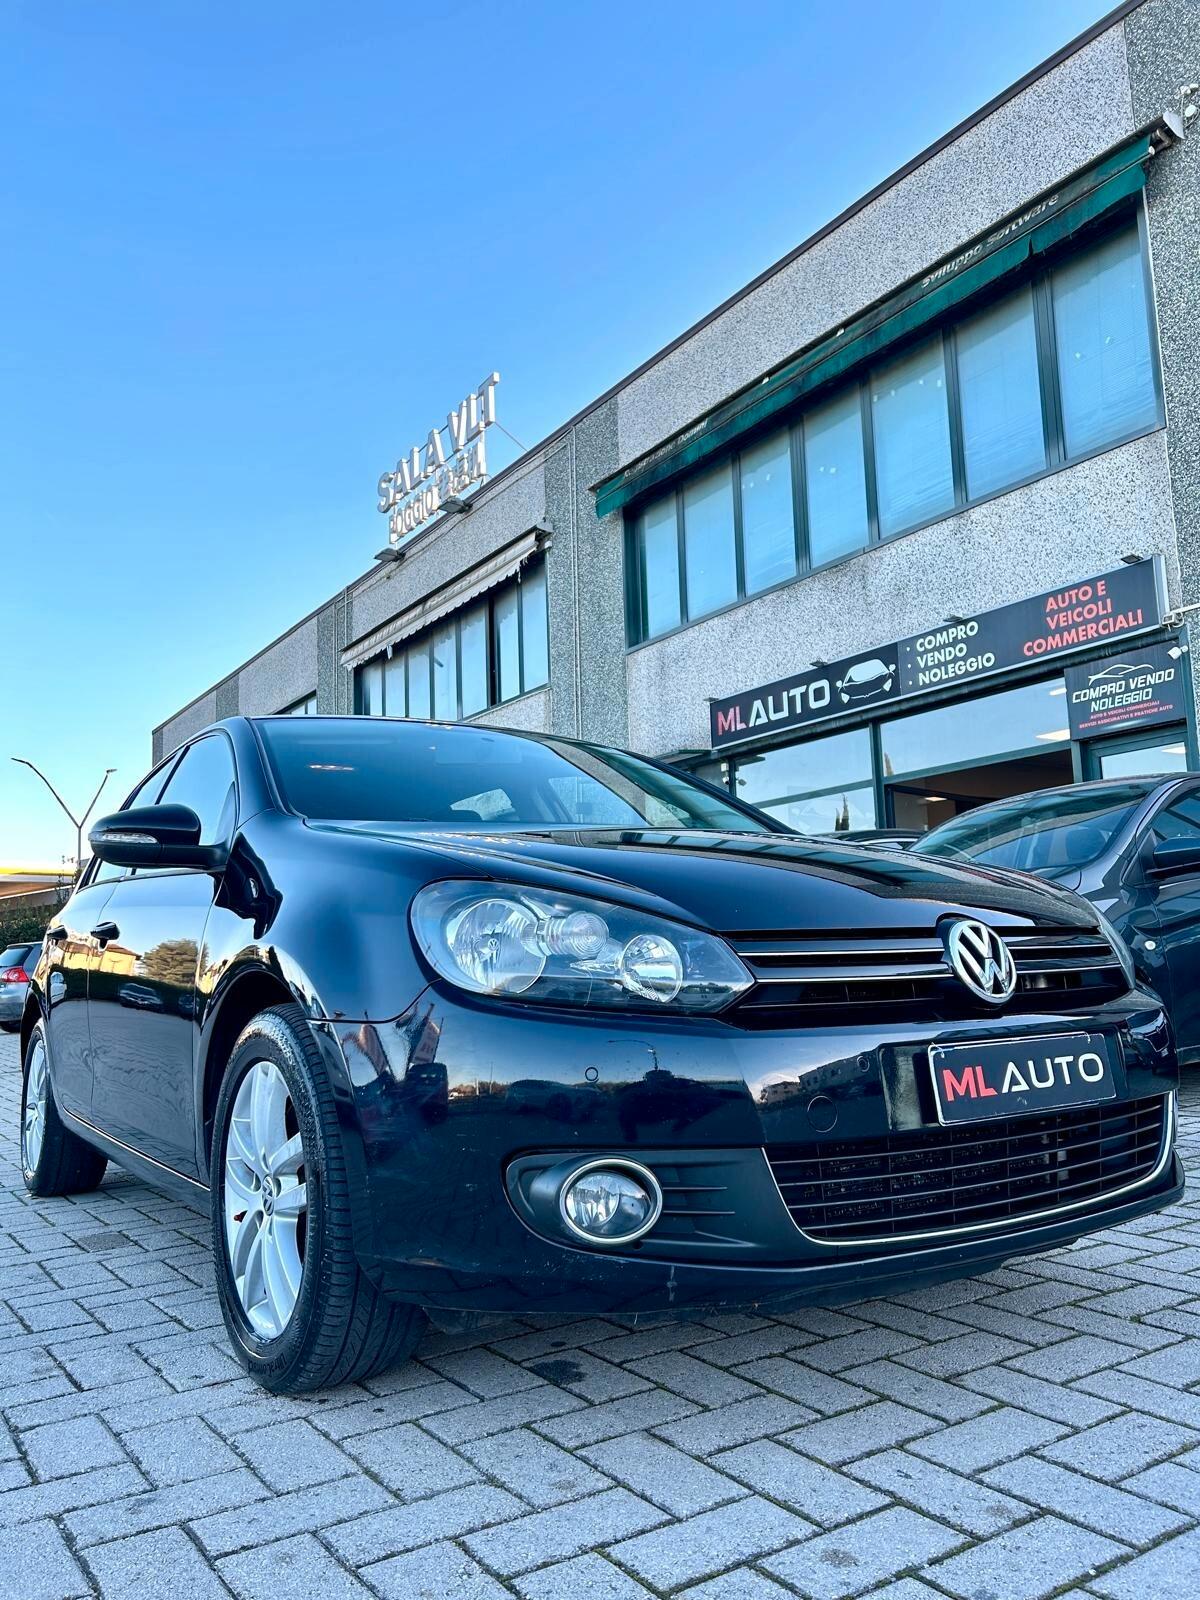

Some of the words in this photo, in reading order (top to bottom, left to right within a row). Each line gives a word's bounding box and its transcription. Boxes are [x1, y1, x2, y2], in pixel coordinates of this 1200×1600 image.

[921, 244, 983, 288] Sviluppo
[377, 428, 446, 513] SALA
[1045, 585, 1093, 613] AUTO
[1097, 580, 1107, 596] E
[1046, 598, 1112, 631] VEICOLI
[916, 621, 979, 652] COMPRO
[1023, 609, 1143, 657] COMMERCIALI
[917, 643, 967, 669] VENDO
[918, 652, 995, 686] NOLEGGIO
[1072, 680, 1126, 704] COMPRO
[1129, 668, 1175, 690] VENDO
[1090, 688, 1153, 713] NOLEGGIO
[717, 705, 747, 736] ML
[749, 679, 831, 727] AUTO
[1134, 708, 1159, 717] PRATICHE
[1159, 704, 1173, 712] AUTO
[943, 1066, 998, 1102] ML
[1001, 1053, 1105, 1094] AUTO
